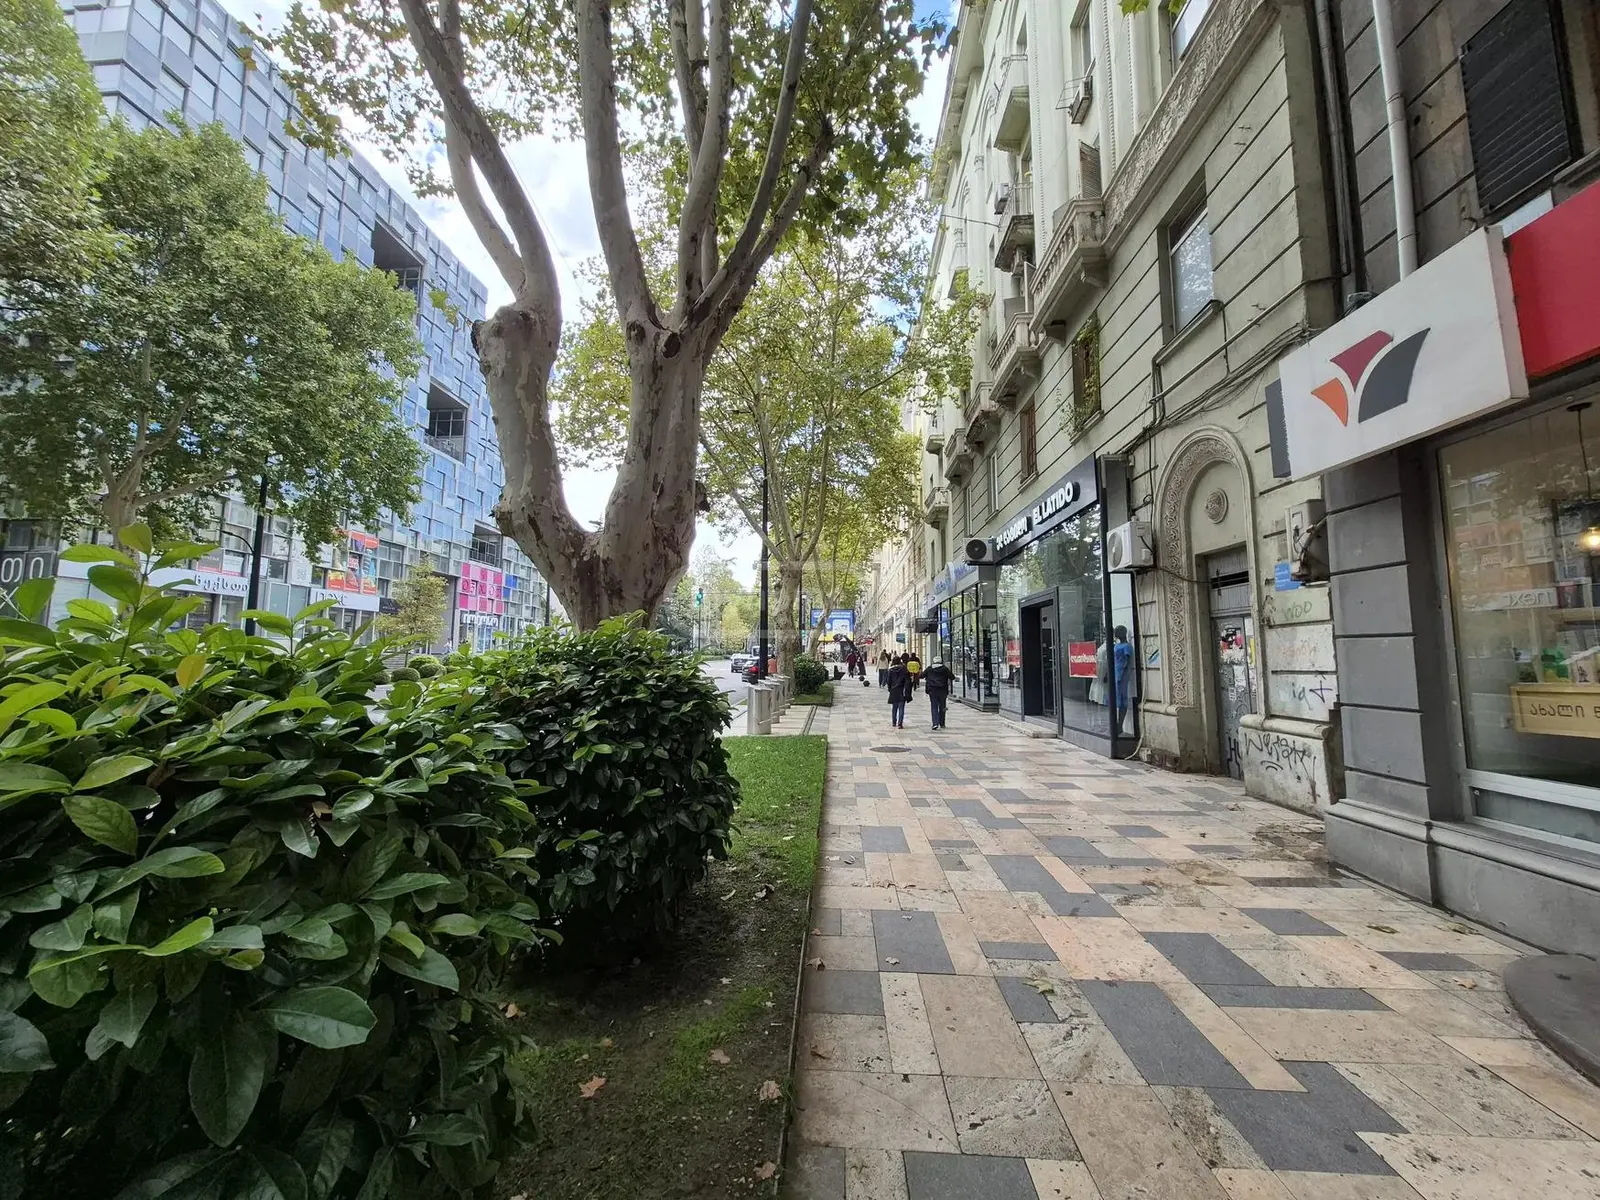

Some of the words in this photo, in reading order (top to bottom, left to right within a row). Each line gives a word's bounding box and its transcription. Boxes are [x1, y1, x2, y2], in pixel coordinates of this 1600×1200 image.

[1032, 505, 1042, 525] EL
[1042, 481, 1074, 519] LATIDO
[1529, 703, 1585, 718] ახალი
